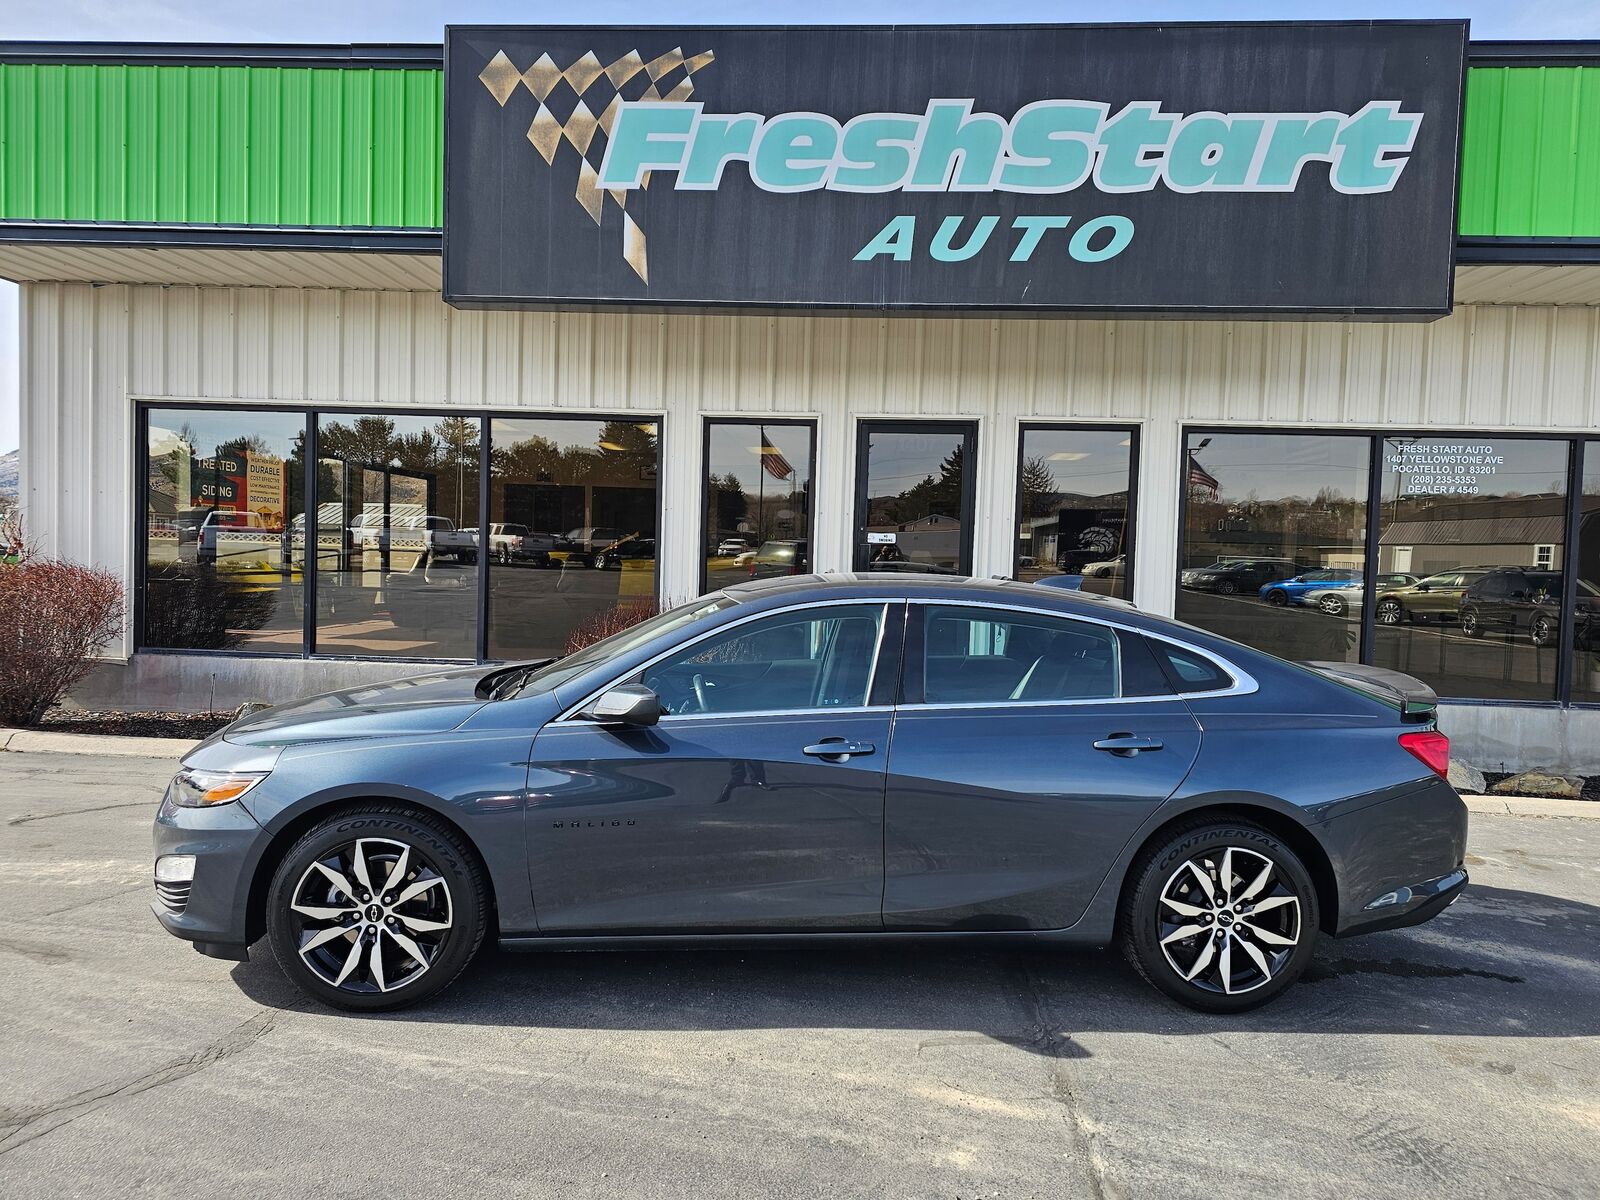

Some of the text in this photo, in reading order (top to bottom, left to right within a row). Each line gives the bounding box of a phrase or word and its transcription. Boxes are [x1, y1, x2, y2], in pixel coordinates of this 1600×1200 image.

[595, 98, 1424, 194] FreshStart
[852, 214, 1135, 262] AUTO
[1398, 445, 1492, 454] FRESH START AUTO
[1386, 455, 1504, 464] 1407 YELLOWSTONE AVE
[250, 465, 280, 476] DURABLE
[1392, 465, 1452, 474] POCATELLO,
[1469, 466, 1496, 474] 83201
[1411, 475, 1476, 485] (208) 235-5353
[202, 484, 232, 498] SIDNG
[1456, 486, 1479, 494] 4549
[250, 496, 280, 504] DECORATIVE
[553, 818, 636, 829] MALIBU
[336, 819, 465, 879] CONTINENTAL
[1159, 829, 1280, 871] CONTINENTAL
